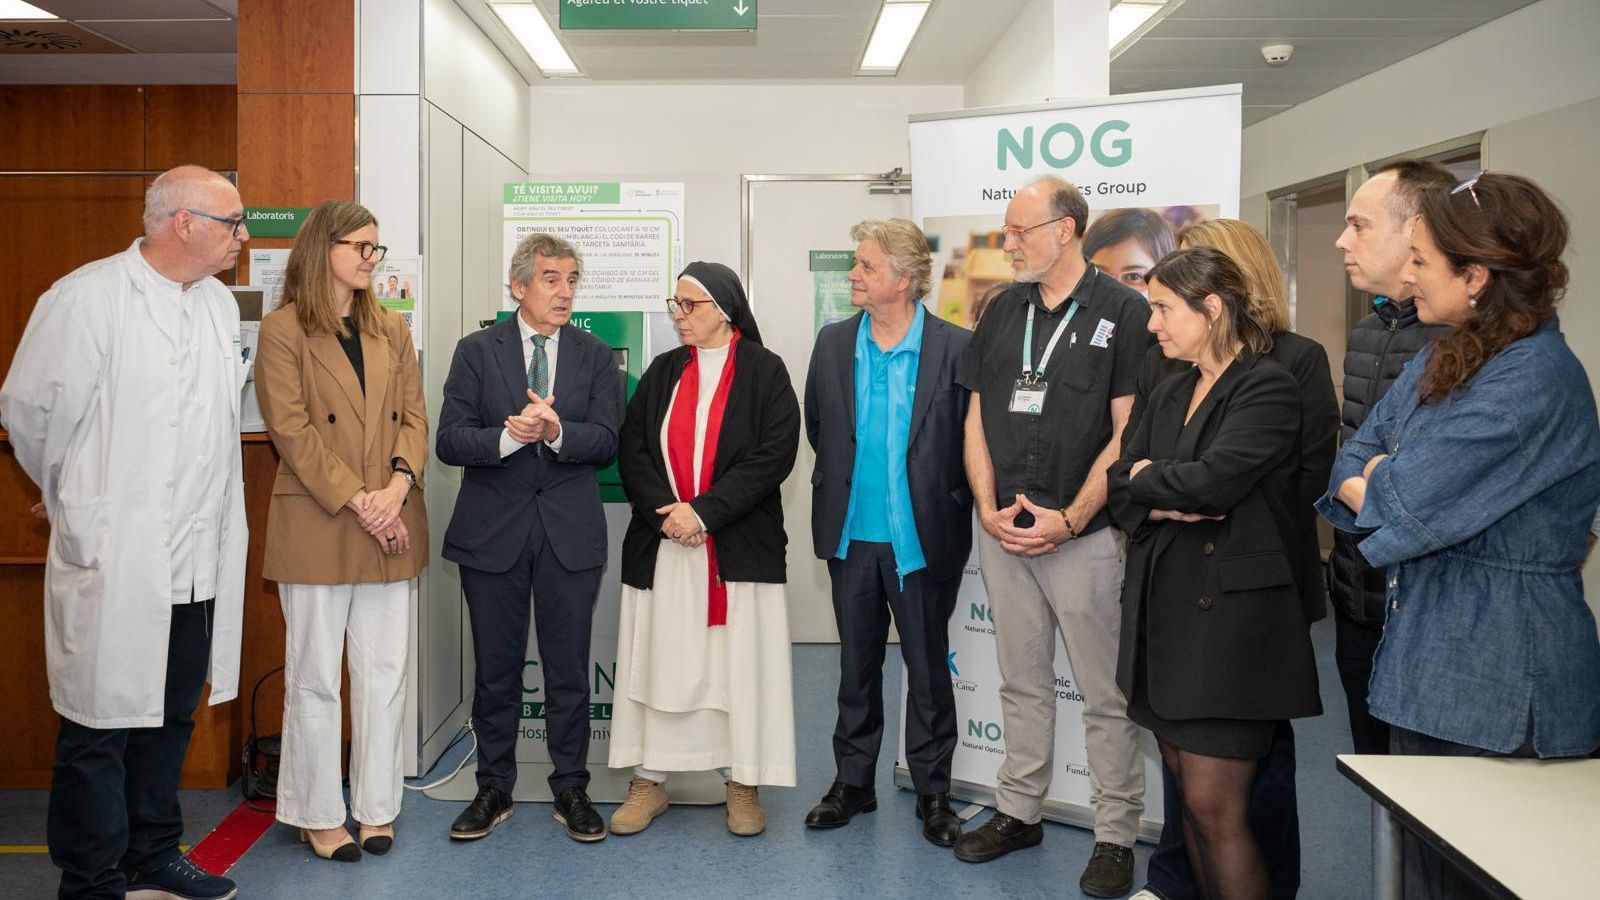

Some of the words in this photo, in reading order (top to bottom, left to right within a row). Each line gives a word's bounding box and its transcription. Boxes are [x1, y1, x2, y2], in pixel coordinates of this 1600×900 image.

[997, 120, 1132, 170] NOG
[512, 183, 526, 194] TÉ
[529, 185, 563, 194] VISITA
[566, 185, 599, 194] AVUI?
[982, 188, 1017, 201] Natu
[1097, 182, 1147, 195] Group
[246, 210, 295, 220] Laboratoris
[1055, 676, 1071, 688] nic
[962, 741, 984, 751] Natural
[1066, 764, 1089, 776] Funda
